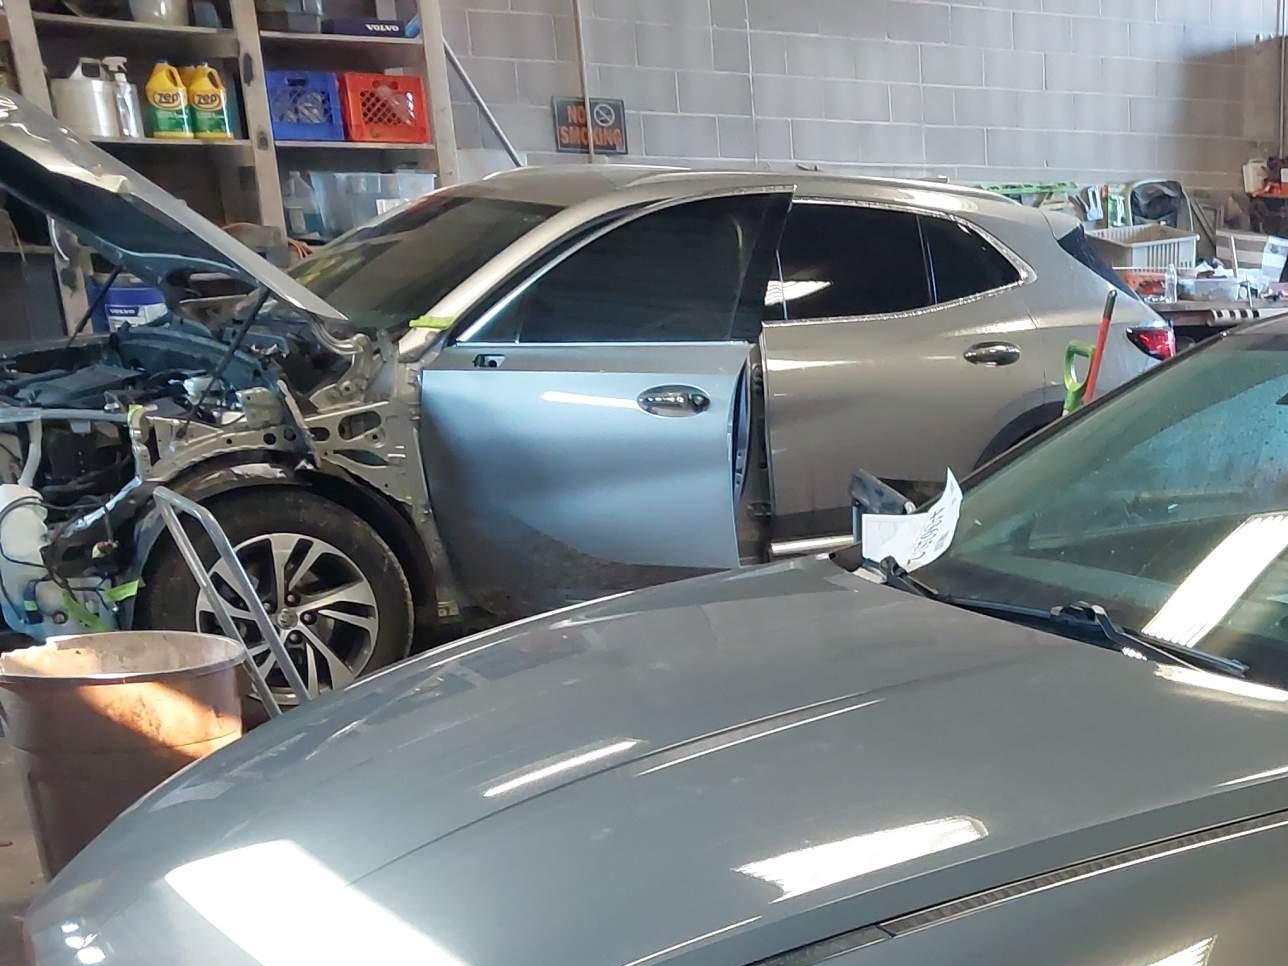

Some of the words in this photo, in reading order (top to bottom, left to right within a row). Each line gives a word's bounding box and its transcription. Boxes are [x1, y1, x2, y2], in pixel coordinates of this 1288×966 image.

[365, 23, 399, 31] VOLVO
[567, 105, 587, 124] NO
[560, 126, 624, 146] SMOKING
